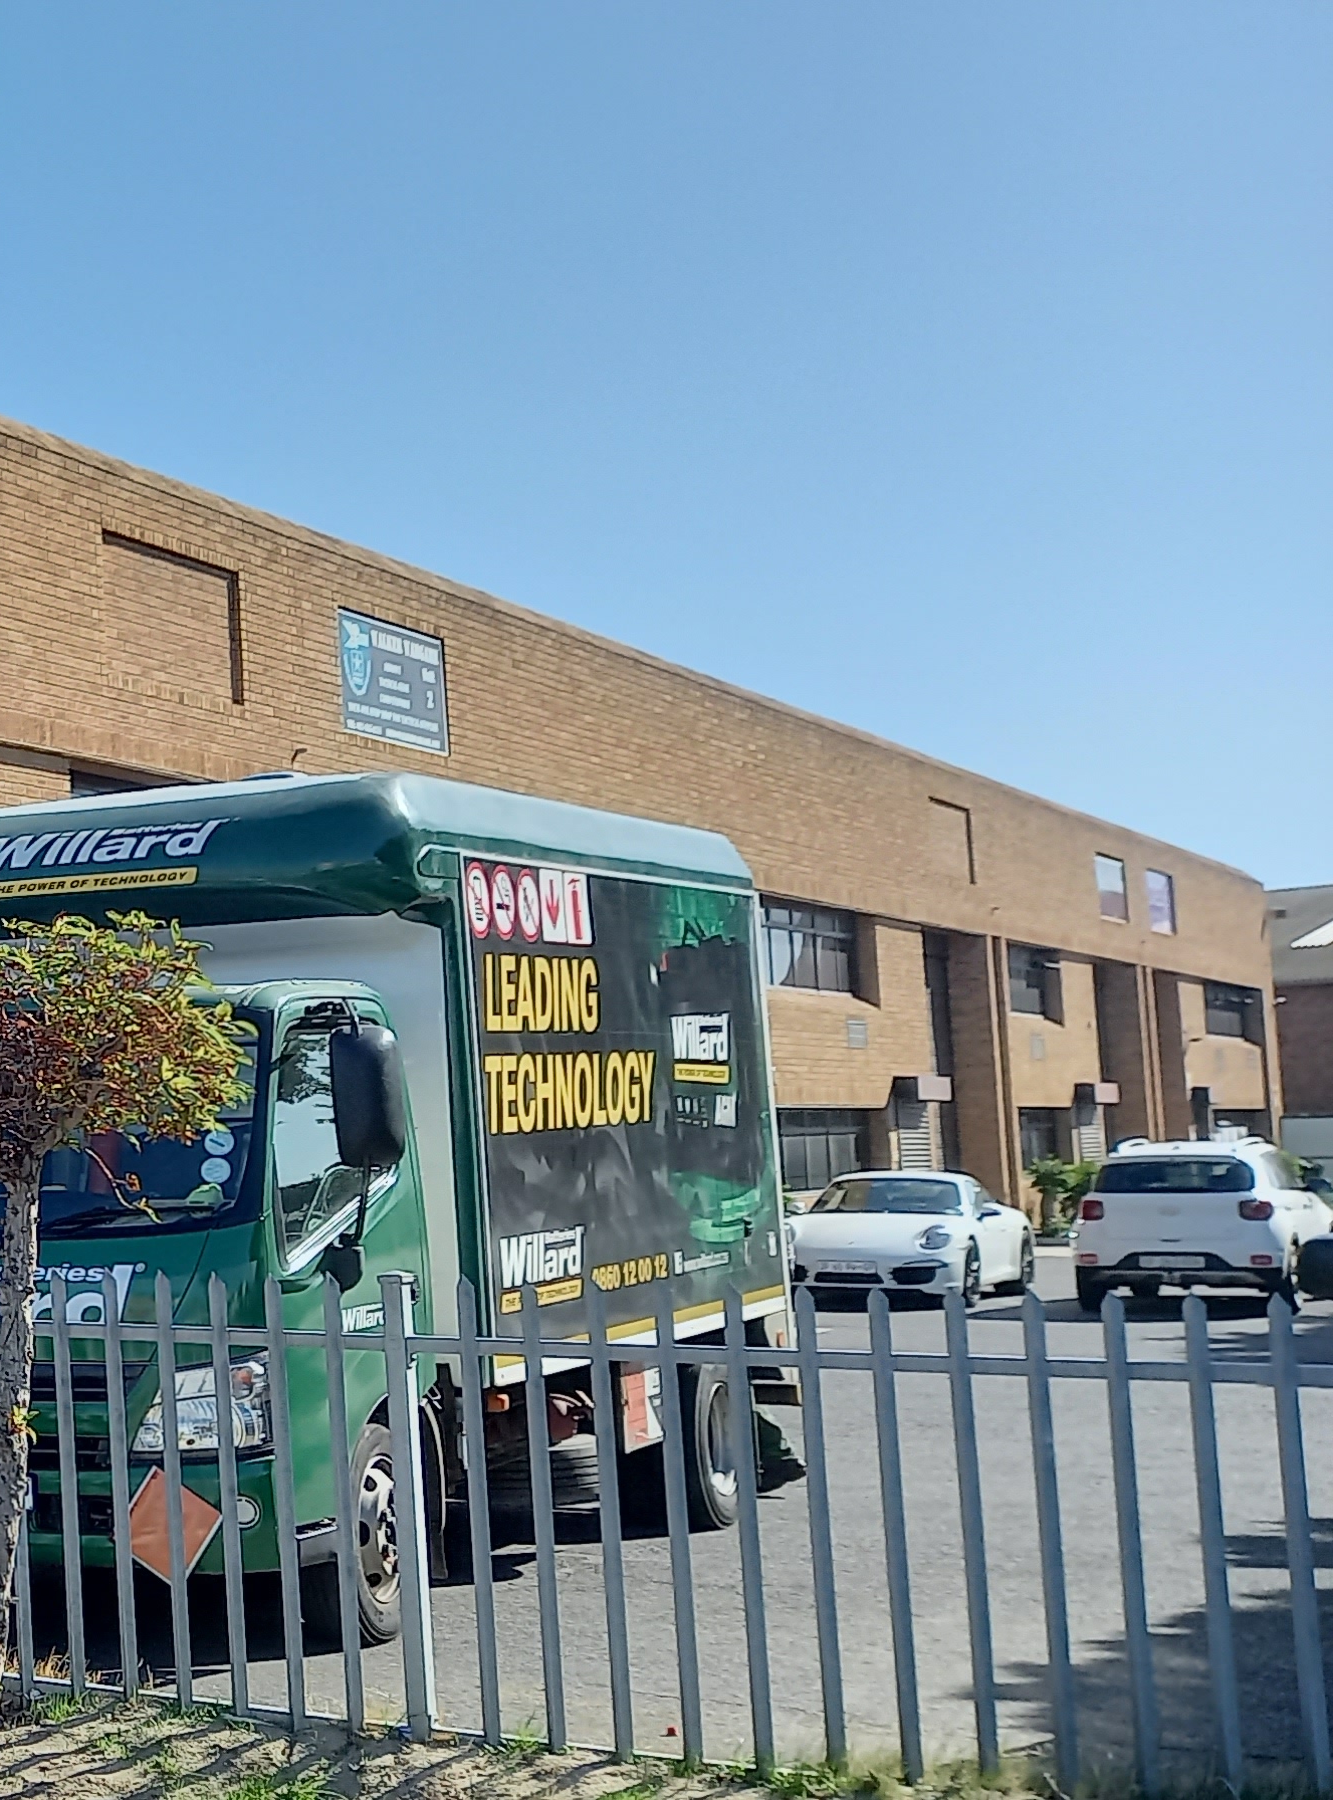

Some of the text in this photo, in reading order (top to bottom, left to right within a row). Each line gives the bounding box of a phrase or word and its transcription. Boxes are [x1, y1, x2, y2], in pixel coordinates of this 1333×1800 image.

[18, 881, 66, 893] POWER
[70, 878, 88, 888] OF
[93, 871, 188, 888] TECHNOLOGY
[484, 954, 599, 1033] LEADING
[670, 1013, 729, 1061] Willard
[485, 1051, 654, 1134] TECHNOLOGY
[499, 1226, 584, 1289] Willard
[623, 1262, 637, 1287] 12
[638, 1259, 652, 1284] 00
[654, 1254, 668, 1279] 12
